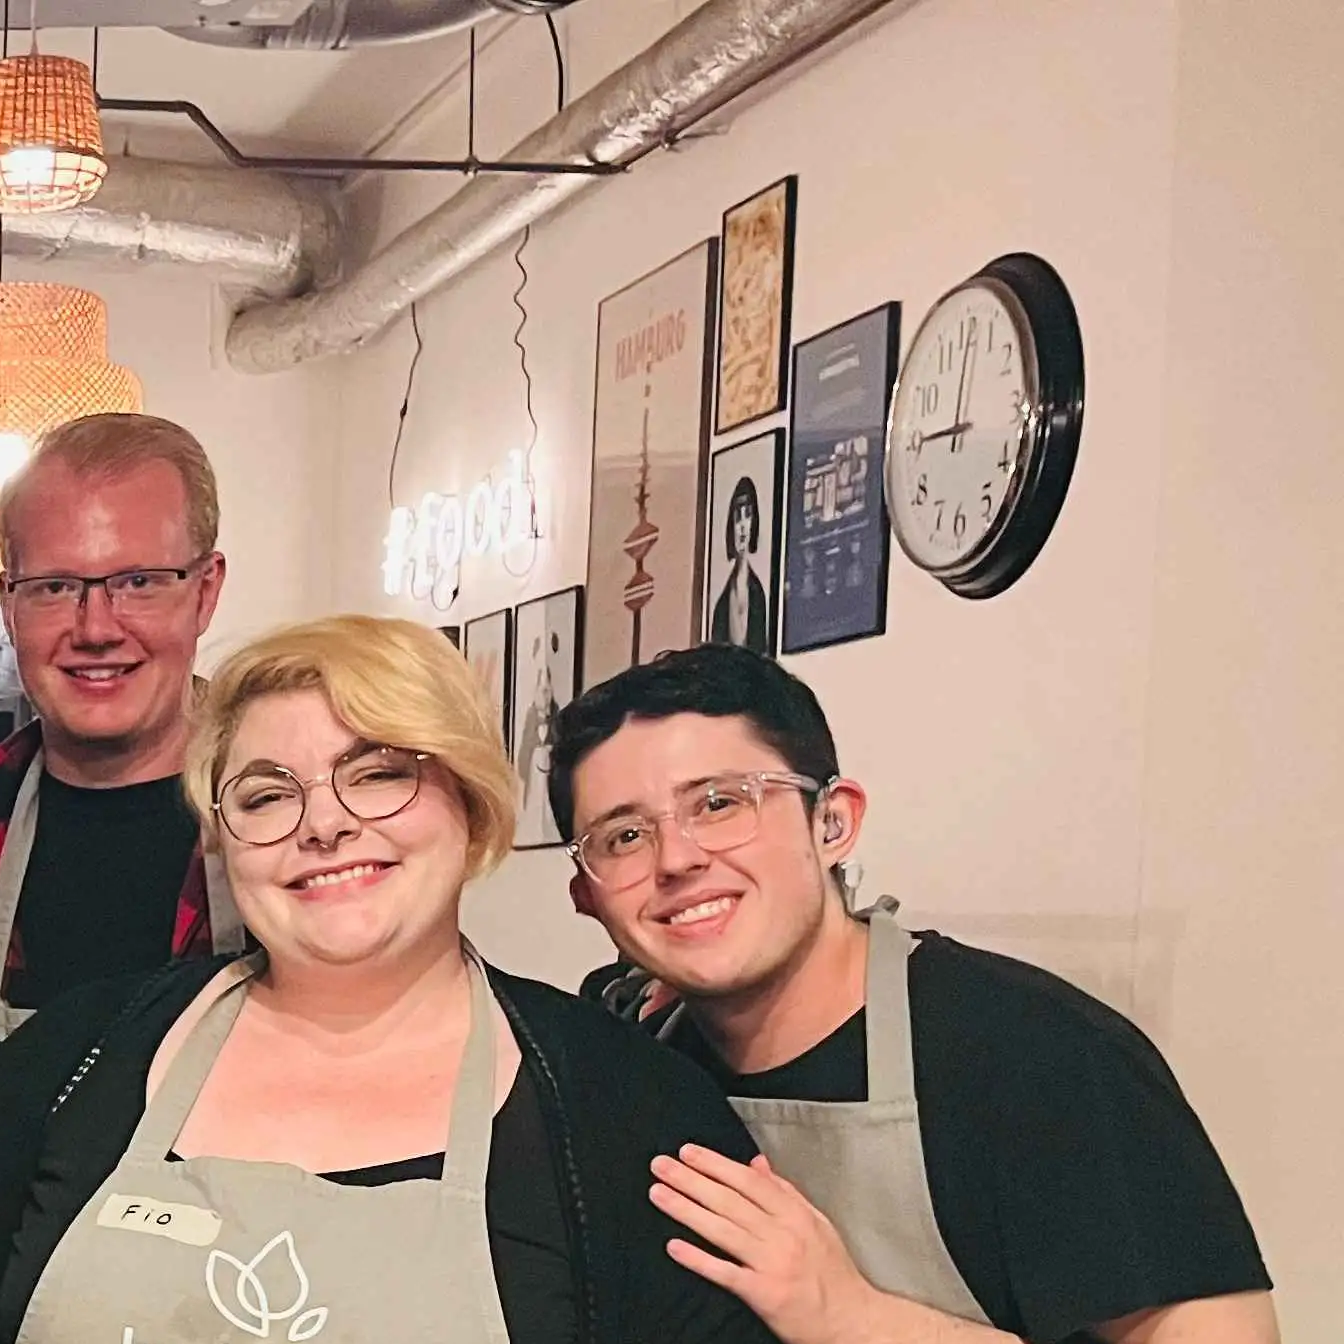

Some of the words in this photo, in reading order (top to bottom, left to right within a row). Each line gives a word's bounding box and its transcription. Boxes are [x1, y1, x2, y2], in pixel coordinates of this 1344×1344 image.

[999, 343, 1014, 376] 2
[916, 382, 939, 418] 10
[934, 499, 946, 532] 7
[953, 500, 966, 538] 6
